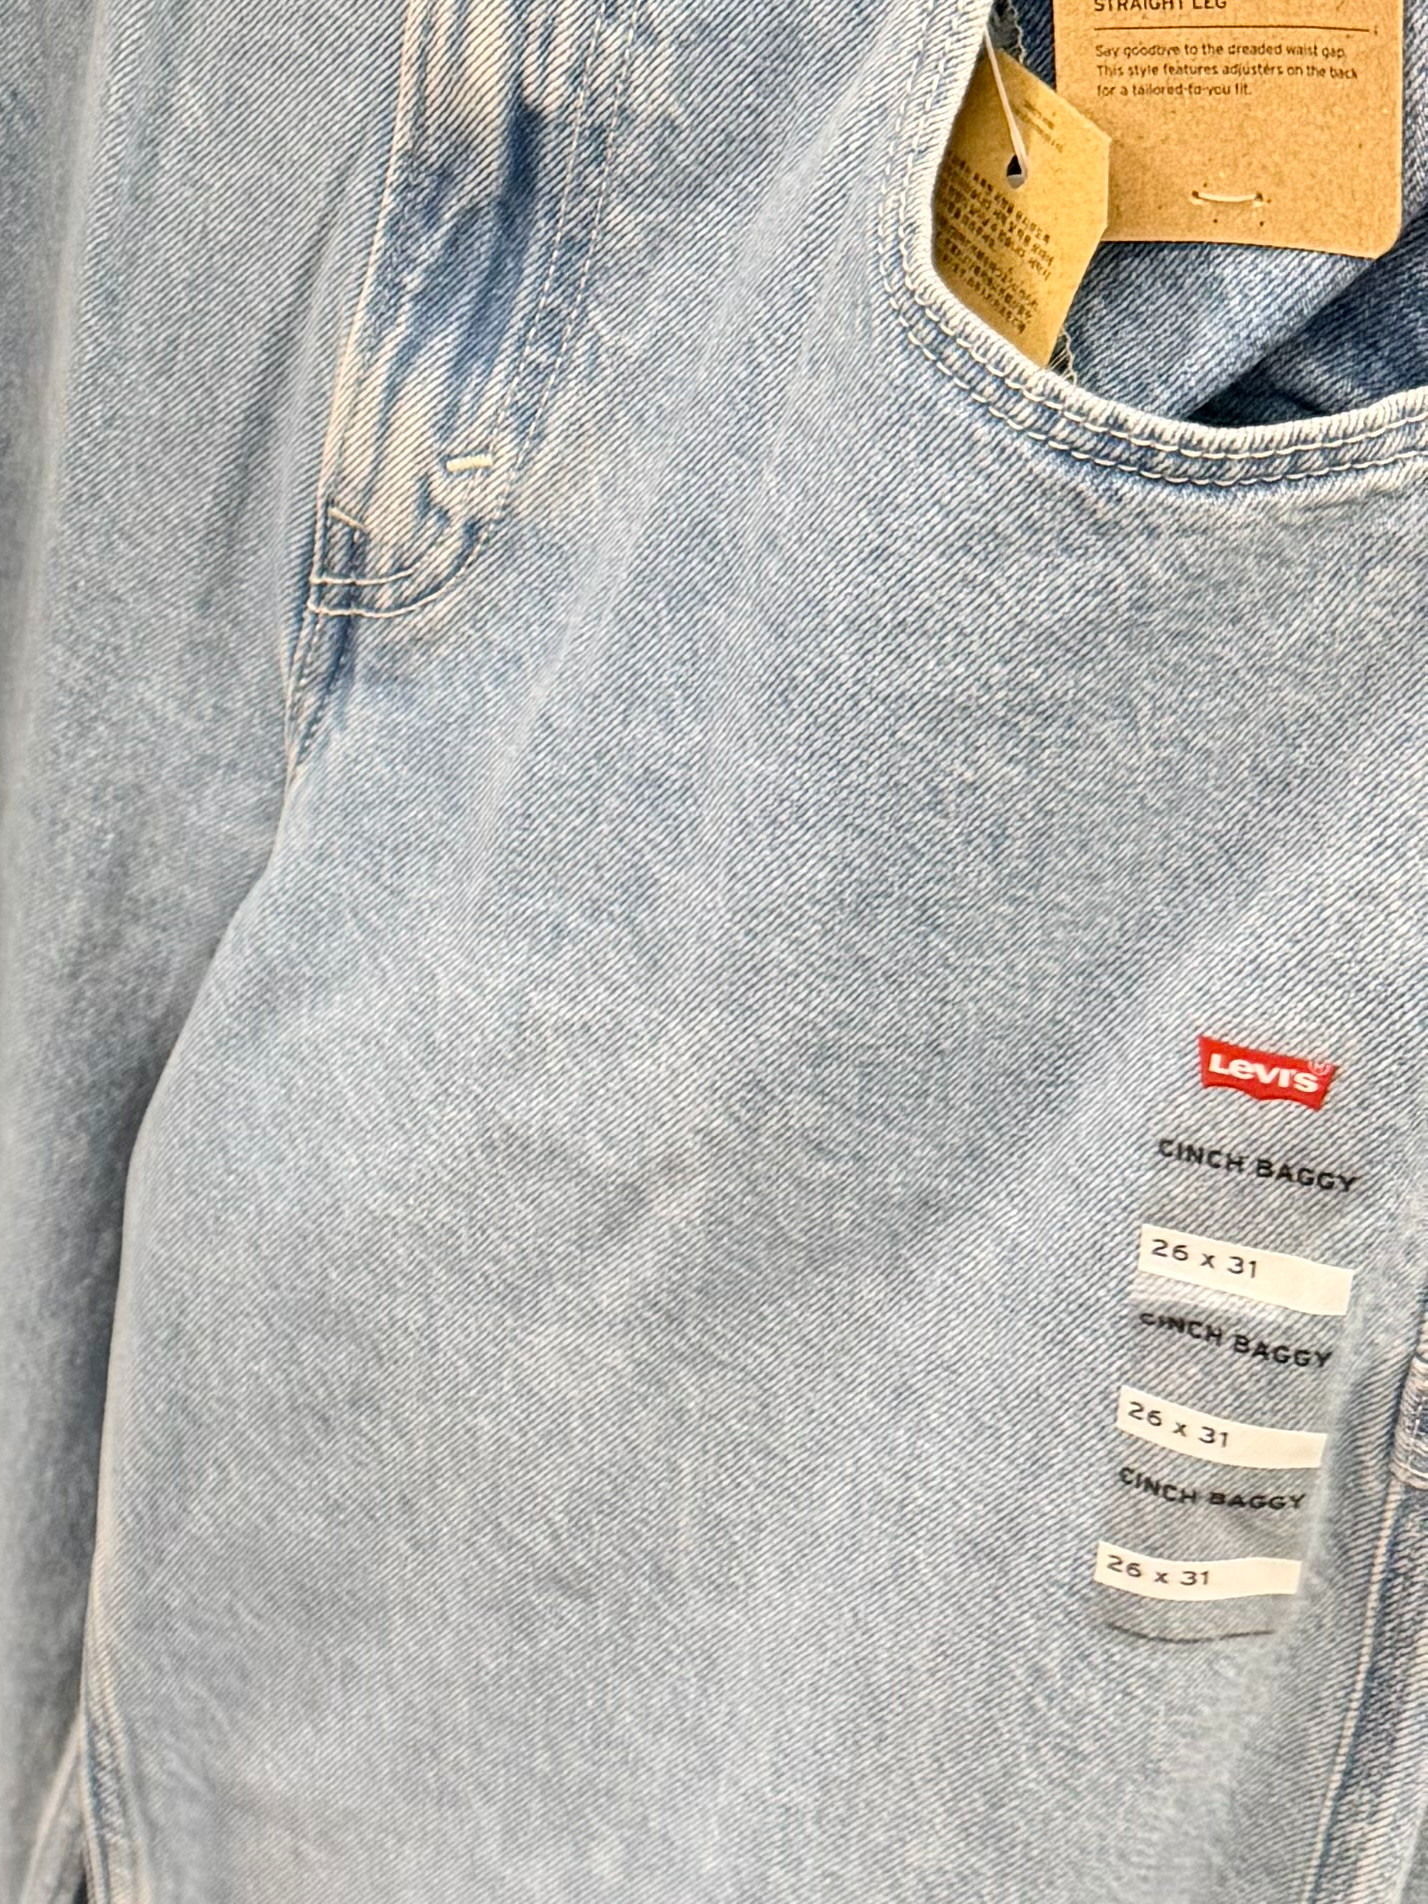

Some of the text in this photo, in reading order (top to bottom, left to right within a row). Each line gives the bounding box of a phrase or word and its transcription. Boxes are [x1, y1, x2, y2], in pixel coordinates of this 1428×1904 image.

[1095, 45, 1120, 58] Say
[1184, 44, 1198, 55] to
[1201, 43, 1224, 56] the
[1227, 43, 1283, 56] dreaded
[1285, 43, 1318, 57] waist
[1097, 61, 1358, 80] This style features adjusters on the back
[1097, 83, 1116, 97] for
[1120, 85, 1129, 96] a
[1156, 1137, 1360, 1192] CINCH BAGGY
[1150, 1238, 1190, 1262] 26
[1227, 1255, 1258, 1279] 31
[1138, 1312, 1333, 1368] CINCH BAGGY
[1127, 1401, 1163, 1427] 26
[1198, 1426, 1229, 1448] 31
[1118, 1466, 1306, 1510] CINCH BAGGY
[1106, 1554, 1143, 1578] 26
[1179, 1570, 1209, 1586] 31
